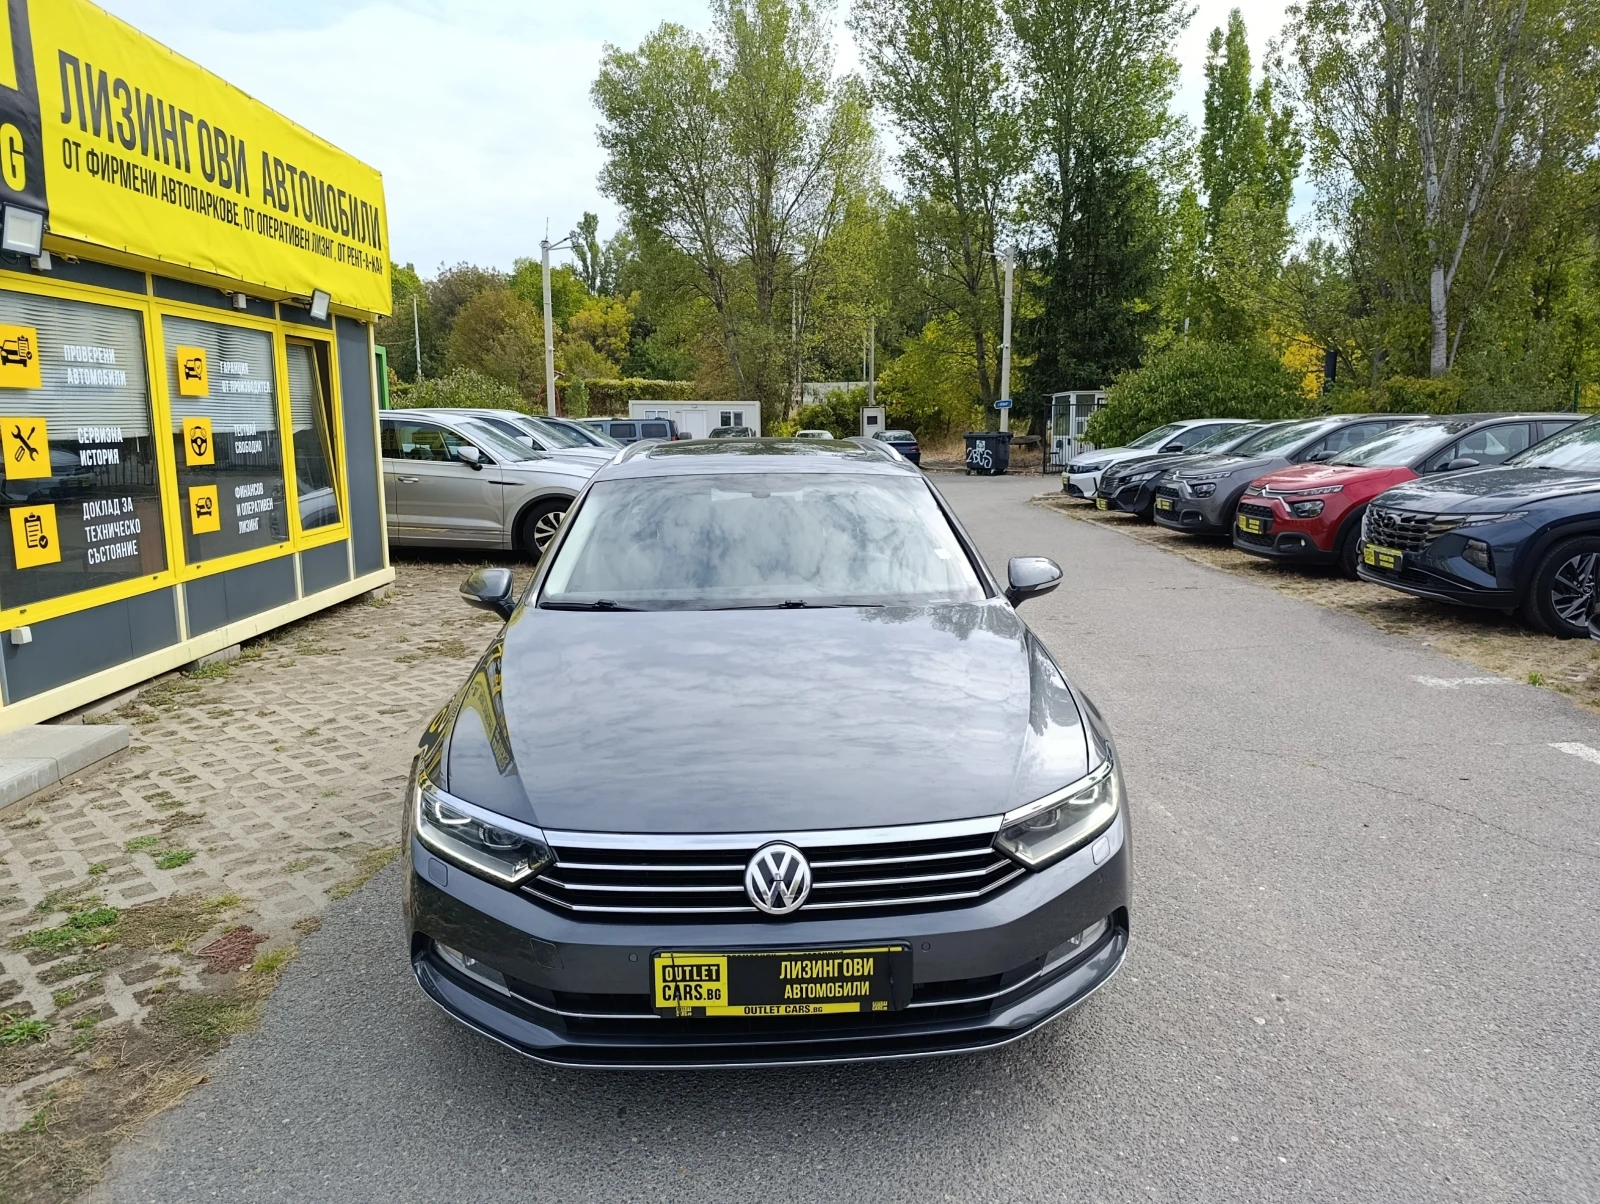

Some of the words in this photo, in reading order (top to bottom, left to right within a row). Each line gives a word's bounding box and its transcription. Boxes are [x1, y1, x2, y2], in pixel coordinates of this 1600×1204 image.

[58, 48, 250, 198] ЛИЗИНГОВИ
[262, 150, 382, 251] АВТОМОБИЛИ
[62, 137, 82, 172] ОТ
[86, 148, 158, 198] ФИРМЕНИ
[161, 174, 243, 231] АВТОПАРКОВЕ,
[243, 206, 255, 233] ОТ
[257, 211, 310, 251] ОПЕРАТИВЕН
[337, 242, 346, 263] ОТ
[63, 344, 116, 364] ПРОВЕРЕНИ
[67, 367, 127, 386] АВТОМОБИЛИ
[77, 427, 123, 444] СЕРВИЗНА
[234, 440, 263, 454] СВОБОДНО
[80, 448, 120, 467] ИСТОРИЯ
[234, 482, 264, 499] ФИНАНСОВ
[82, 498, 121, 521] ДОКЛАД
[121, 496, 134, 513] ЗА
[236, 503, 241, 517] И
[241, 497, 274, 516] ОПЕРАТИВЕН
[84, 518, 141, 543] ТЕХНИЧЕСКО
[87, 539, 139, 565] СЪСТОЯНИЕ
[665, 966, 719, 982] OUTLET
[780, 957, 875, 980] ЛИЗИНГОВИ
[662, 983, 722, 1002] CARS.BG
[784, 981, 870, 999] АВТОМОБИЛИ
[744, 1005, 782, 1015] OUTLET
[784, 1004, 823, 1014] CARS.BG
